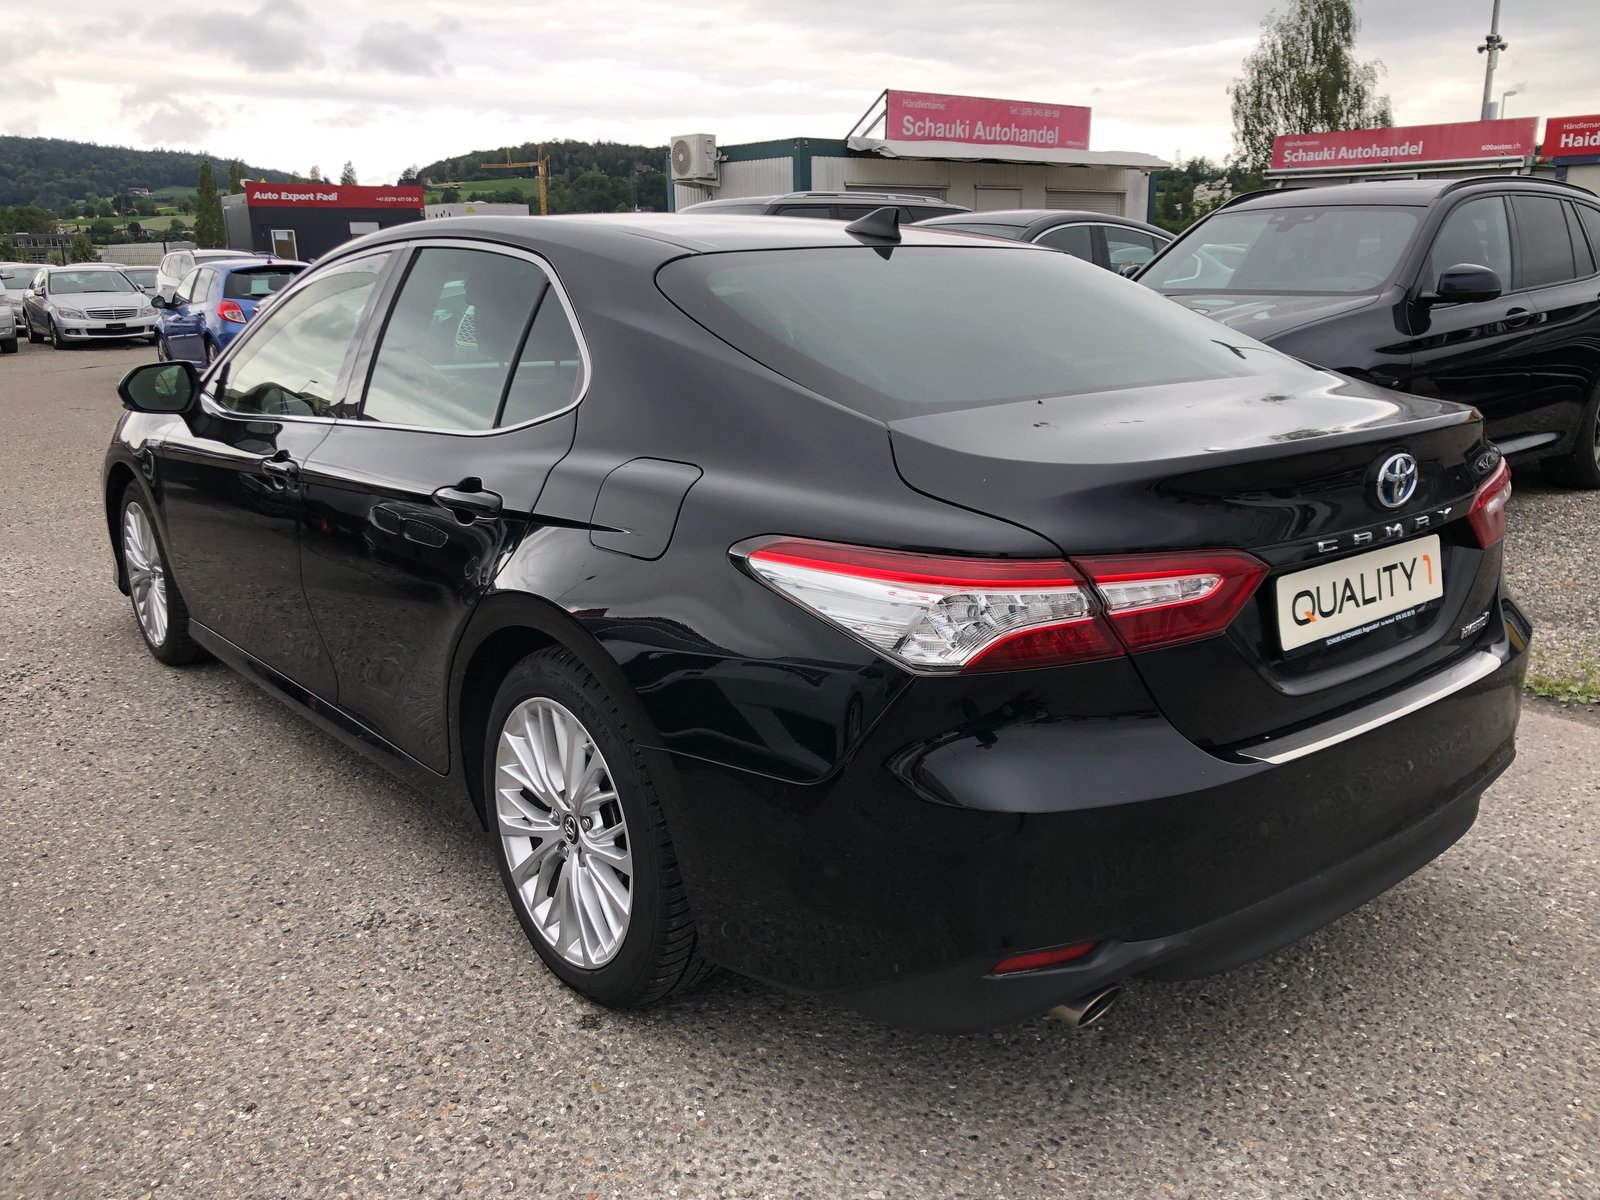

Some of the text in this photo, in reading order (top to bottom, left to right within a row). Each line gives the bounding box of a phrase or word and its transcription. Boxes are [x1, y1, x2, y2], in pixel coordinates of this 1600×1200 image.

[902, 115, 1059, 144] Schauki Autohandel
[1283, 140, 1424, 162] Schauki Autohandel
[1481, 143, 1521, 151] 600autos.ch
[253, 191, 338, 202] Auto Export Fadi
[1317, 507, 1452, 553] CAMRY
